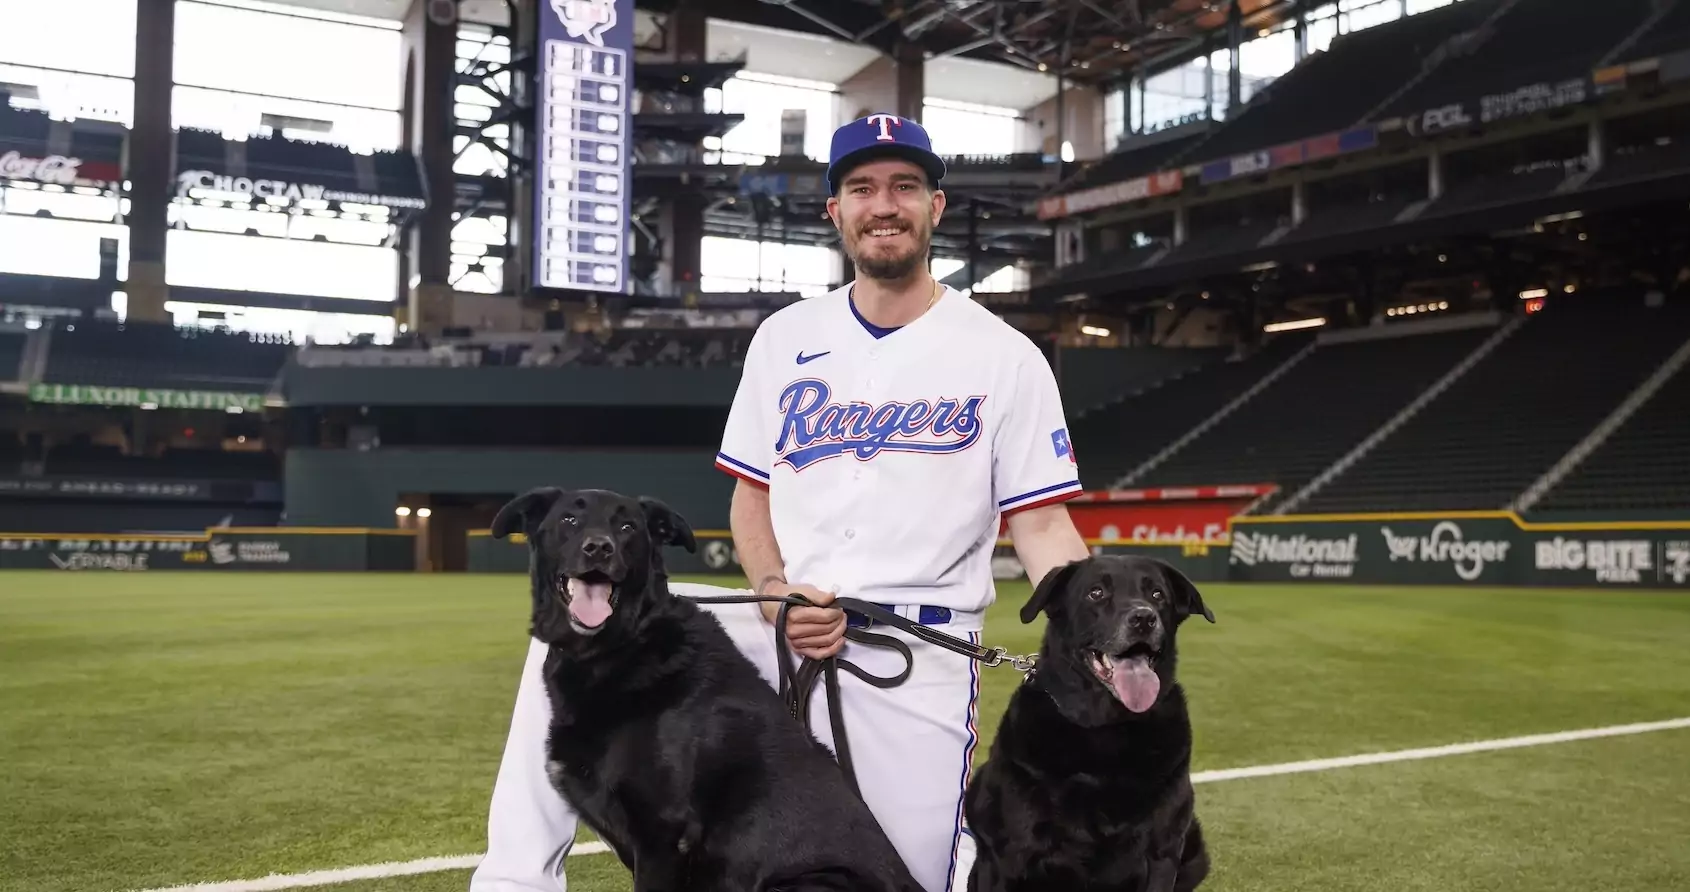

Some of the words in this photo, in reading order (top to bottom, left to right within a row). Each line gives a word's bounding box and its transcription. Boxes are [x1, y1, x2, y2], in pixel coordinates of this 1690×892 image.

[867, 114, 901, 143] T
[774, 377, 987, 466] Rangers
[1257, 532, 1358, 562] National
[1420, 520, 1511, 580] Kroger
[1586, 540, 1652, 570] BITE
